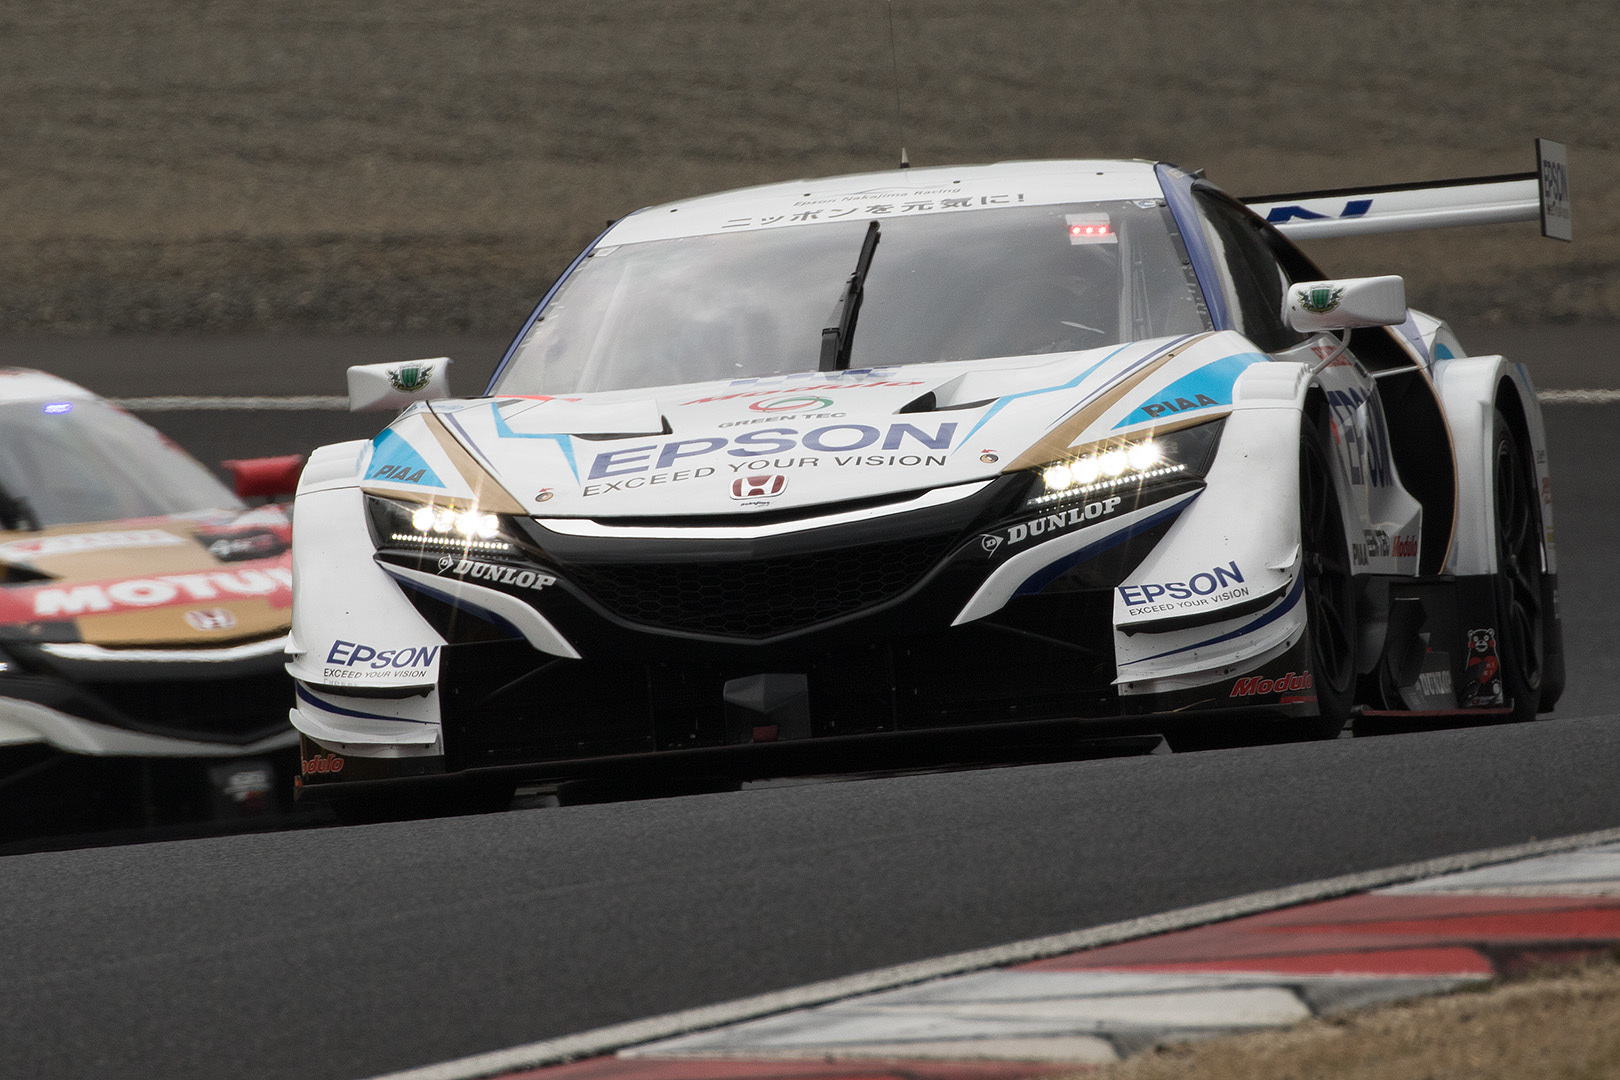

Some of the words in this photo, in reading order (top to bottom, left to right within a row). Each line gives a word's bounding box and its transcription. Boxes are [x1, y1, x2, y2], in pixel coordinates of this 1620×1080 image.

[793, 199, 837, 208] Epson
[841, 192, 908, 203] Nakajima
[913, 187, 962, 197] Racing
[1140, 393, 1219, 418] PIAA
[718, 415, 796, 429] GREEN
[802, 412, 847, 420] TEC
[587, 422, 958, 481] EPSON
[372, 464, 427, 484] PIAA
[582, 467, 716, 497] EXCEED
[728, 456, 819, 474] YOUR
[834, 454, 949, 468] VISION
[1007, 496, 1122, 545] DUNLOP
[452, 559, 557, 591] DUNLOP
[1118, 560, 1245, 606] EPSON
[1129, 603, 1175, 616] EXCEED
[1176, 599, 1209, 608] YOUR
[1211, 587, 1249, 603] VISION
[326, 639, 440, 669] EPSON
[323, 668, 363, 679] EXCEED
[365, 670, 391, 678] YOUR
[393, 670, 427, 678] VISION
[1229, 670, 1313, 697] Modulo
[301, 754, 345, 774] odulo
